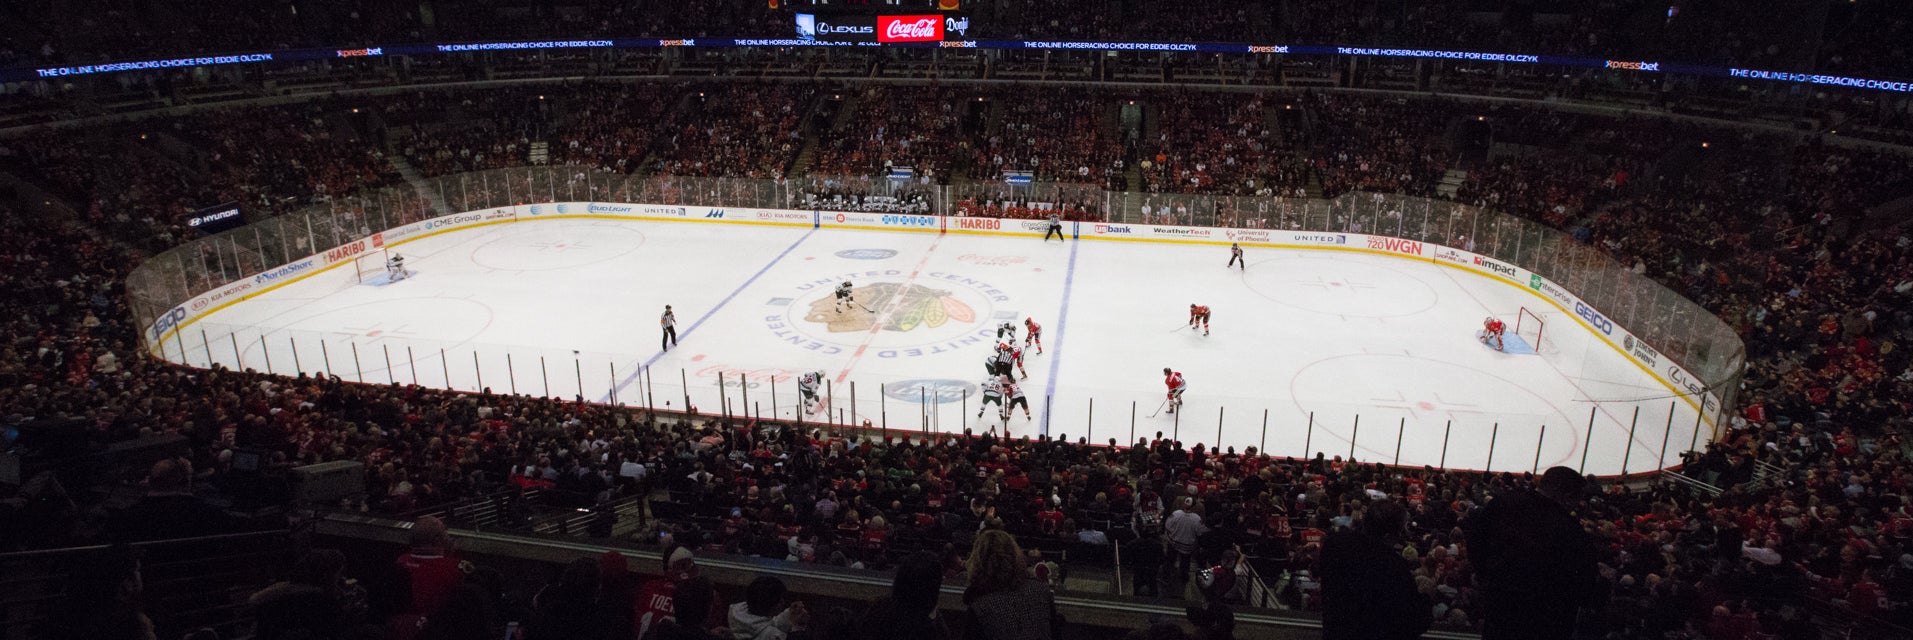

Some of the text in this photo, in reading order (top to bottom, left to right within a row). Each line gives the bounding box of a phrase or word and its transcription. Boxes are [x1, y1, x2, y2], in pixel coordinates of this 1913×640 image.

[829, 25, 874, 33] LEXUS
[887, 18, 937, 38] Coca-Cola
[480, 42, 528, 50] HORSERACING
[659, 39, 695, 47] xpressbet
[939, 40, 977, 48] xpressbet
[1248, 44, 1289, 53] xpressbet
[337, 47, 383, 57] xpressbet
[1381, 49, 1434, 57] HORSERACING
[1434, 51, 1464, 59] CHOICE
[1464, 52, 1481, 60] FOR
[1481, 53, 1505, 61] EDDIE
[1505, 54, 1538, 62] OLCZYK
[37, 53, 272, 77] THE ONLINE HORSERACING CHOICE FOR EDDIE OLCZYK
[1605, 59, 1659, 71] xpressbet
[1729, 68, 1749, 77] THE
[1750, 70, 1788, 80] ONLINE
[1789, 73, 1866, 87] HORSERACING
[1866, 80, 1907, 92] CHOICE
[203, 208, 239, 223] HYUNDAI
[434, 218, 453, 228] CME
[454, 213, 482, 224] Group
[960, 218, 1001, 230] HARIBO
[1108, 225, 1131, 233] bank
[1153, 227, 1211, 236] WeatherTech
[329, 241, 365, 263] HARIBO
[1367, 240, 1384, 250] 720
[1385, 237, 1423, 255] WGN
[261, 260, 313, 280] NorthShore
[1482, 257, 1516, 277] impact
[211, 283, 251, 301] KIA MOTORS
[797, 269, 1009, 303] UNITED CENTER
[1531, 276, 1571, 304] enterprise
[1575, 301, 1612, 335] GEICO
[765, 315, 842, 354] CENTER
